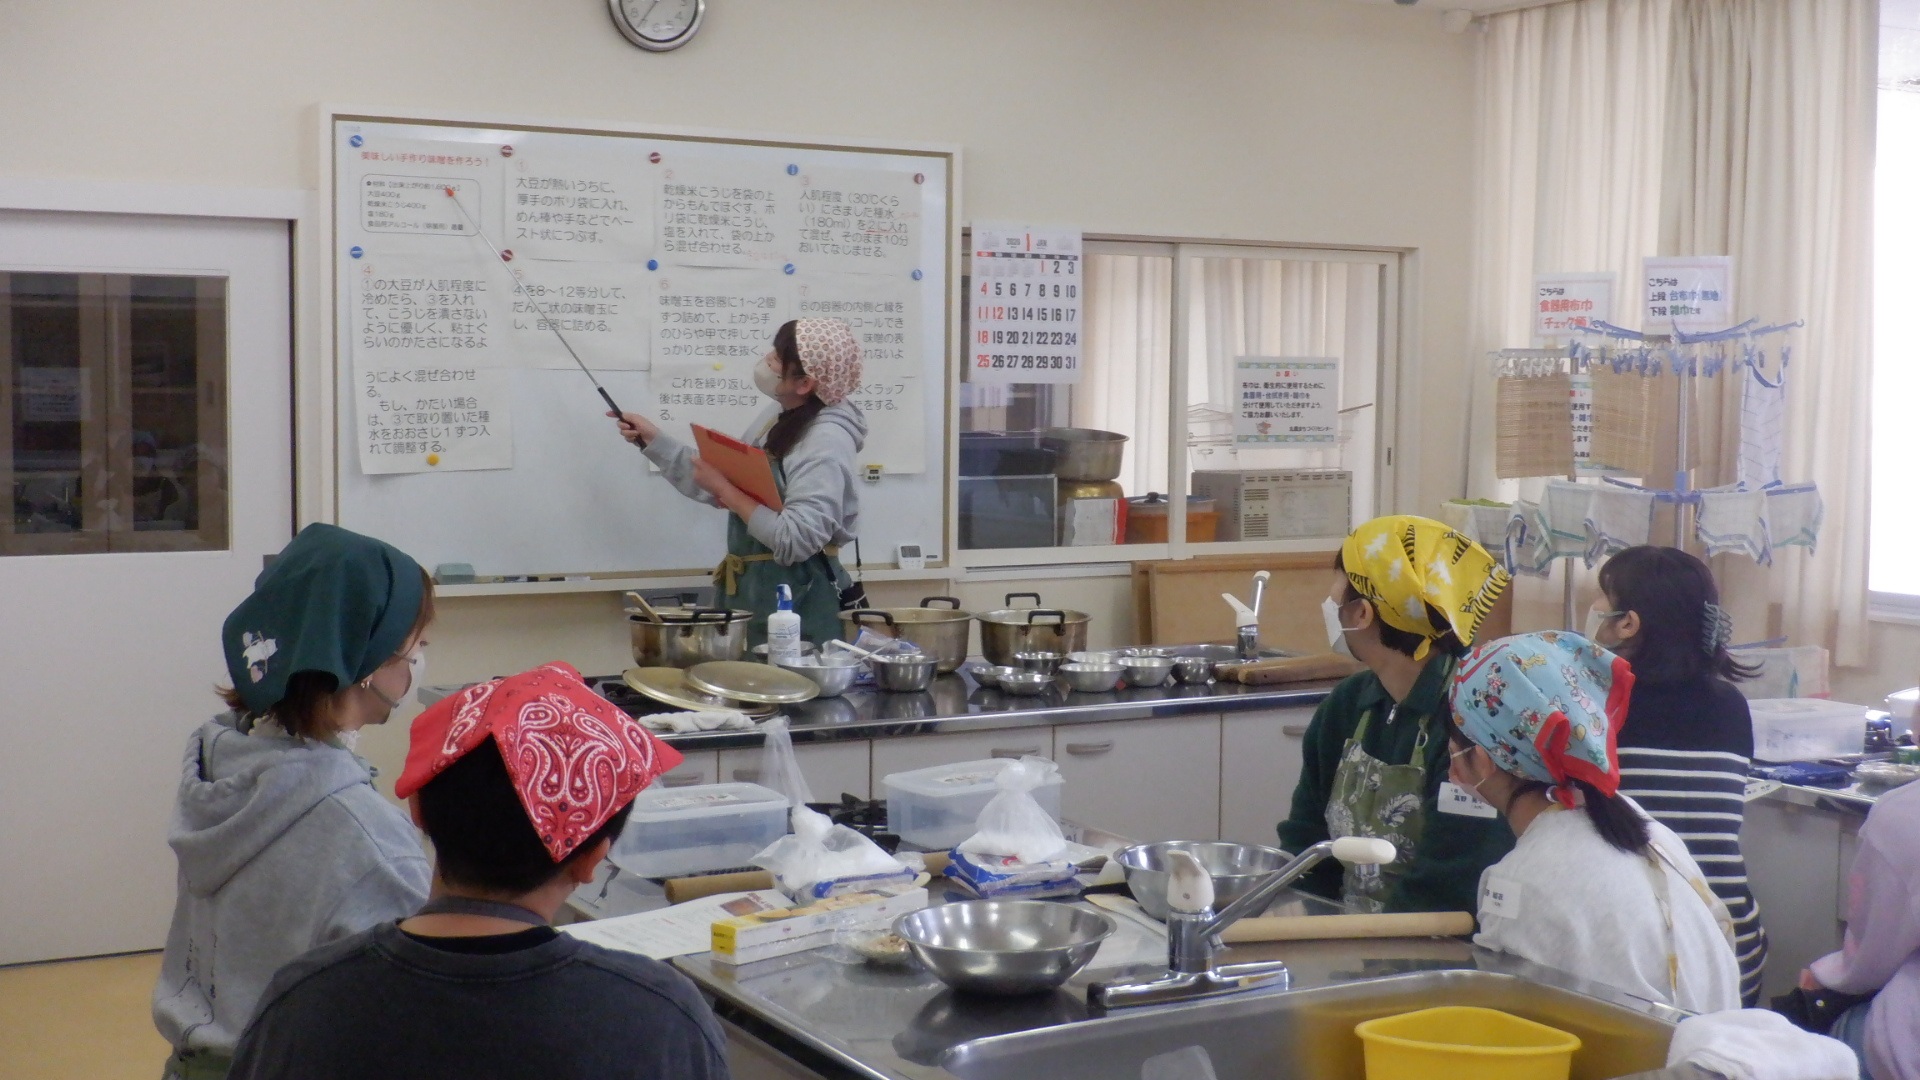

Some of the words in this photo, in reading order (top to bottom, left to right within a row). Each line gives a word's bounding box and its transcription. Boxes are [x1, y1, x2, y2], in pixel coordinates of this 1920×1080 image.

[516, 178, 615, 193] 大豆が熱いうちに、
[664, 184, 774, 202] 乾燥米こうじを袋の上
[516, 228, 603, 243] スト状につぶす。
[1026, 233, 1030, 251] 1
[1041, 260, 1044, 273] 1
[1054, 261, 1060, 274] 2
[1068, 262, 1074, 274] 3
[1648, 278, 1678, 287] こちらは
[981, 282, 987, 295] 4
[995, 282, 1002, 296] 5
[1010, 283, 1016, 296] 6
[1025, 284, 1031, 296] 7
[1039, 284, 1046, 297] 8
[1054, 284, 1060, 298] 9
[1066, 285, 1076, 298] 10
[1540, 288, 1564, 296] こちらは
[1649, 292, 1666, 301] 上段
[1540, 299, 1593, 313] 食器用布巾
[1649, 306, 1667, 316] 下段
[1670, 304, 1701, 316] 雑巾です
[364, 308, 488, 320] て、こうじを潰さない
[661, 312, 770, 324] ずつ詰めて、上から手
[978, 306, 988, 319] 11
[993, 306, 1004, 320] 12
[1008, 307, 1018, 320] 13
[1022, 307, 1033, 320] 14
[1037, 308, 1047, 321] 15
[1051, 308, 1061, 321] 16
[1066, 309, 1076, 322] 17
[363, 322, 488, 334] ように優しく、粘土ぐ
[513, 319, 612, 332] し、容器に詰める。
[661, 328, 771, 340] のひらや甲で押してし
[977, 330, 988, 344] 18
[993, 331, 1003, 344] 19
[1007, 331, 1019, 344] 20
[1022, 332, 1033, 344] 21
[1037, 332, 1048, 345] 22
[1051, 332, 1062, 345] 23
[1065, 333, 1076, 345] 24
[364, 336, 488, 348] らいのかたさになるよ
[662, 344, 764, 357] っかりと空気を抜く。
[977, 355, 989, 368] 25
[992, 355, 1004, 368] 26
[1007, 355, 1019, 368] 27
[1022, 356, 1033, 368] 28
[1036, 356, 1048, 369] 29
[1051, 356, 1062, 369] 30
[1066, 356, 1076, 369] 31
[366, 370, 476, 382] うによく混ぜ合わせ
[366, 386, 382, 398] る。
[380, 397, 478, 412] もし、かたい場合
[660, 394, 759, 406] 後は表面を平らにす
[660, 410, 675, 422] る。
[370, 440, 448, 454] れて調整する。
